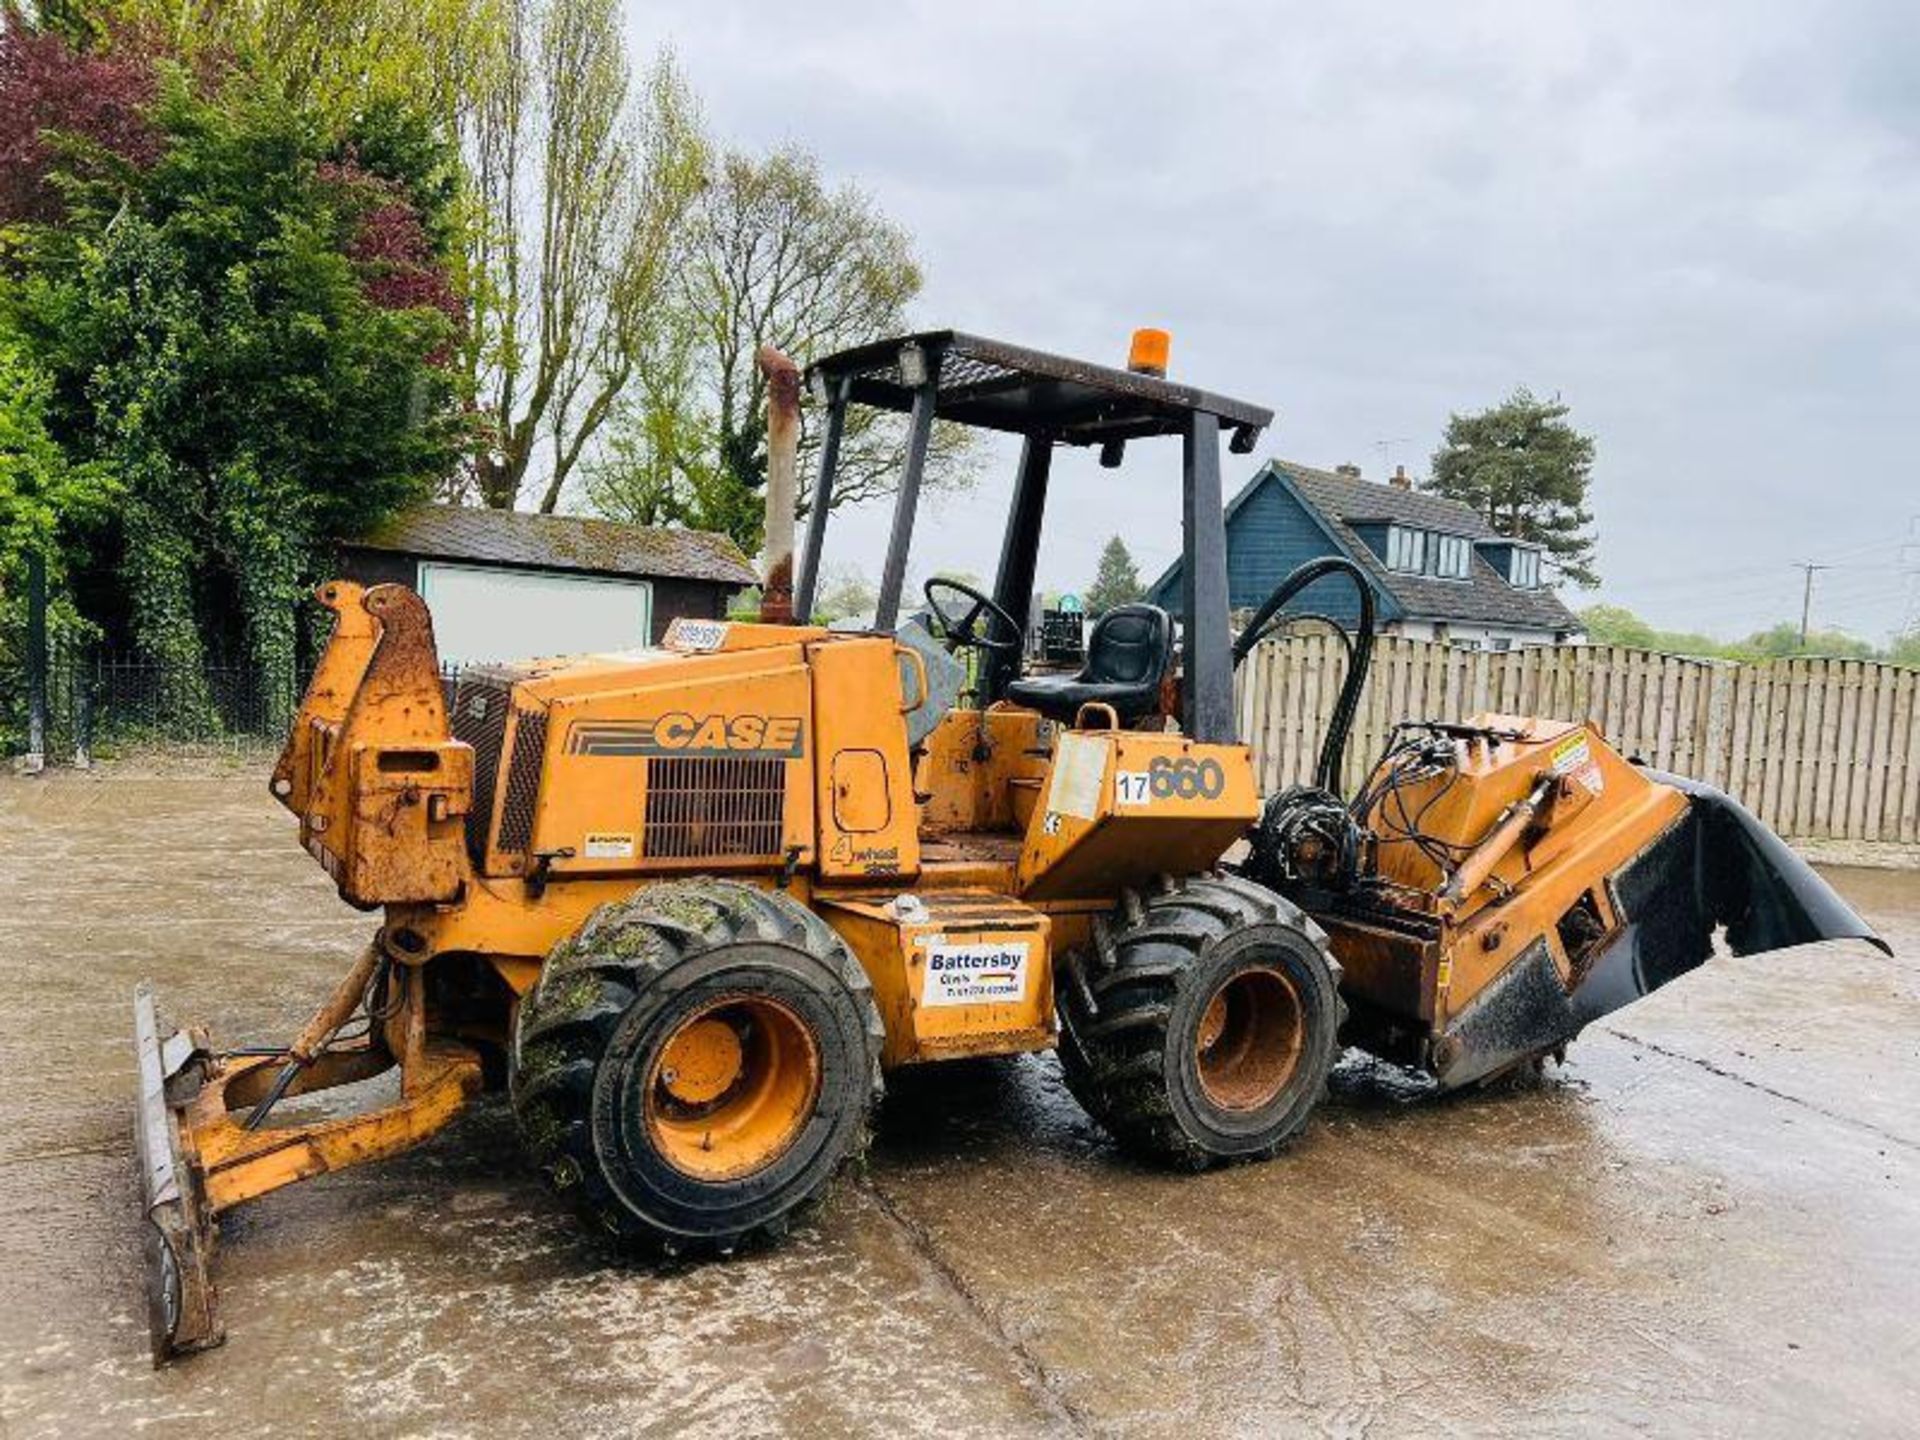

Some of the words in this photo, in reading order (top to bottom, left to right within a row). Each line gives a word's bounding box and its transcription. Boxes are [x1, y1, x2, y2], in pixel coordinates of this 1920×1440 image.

[652, 711, 802, 750] CASE
[1118, 776, 1148, 800] 17
[1150, 755, 1225, 799] 660
[931, 952, 1021, 971] Battersby
